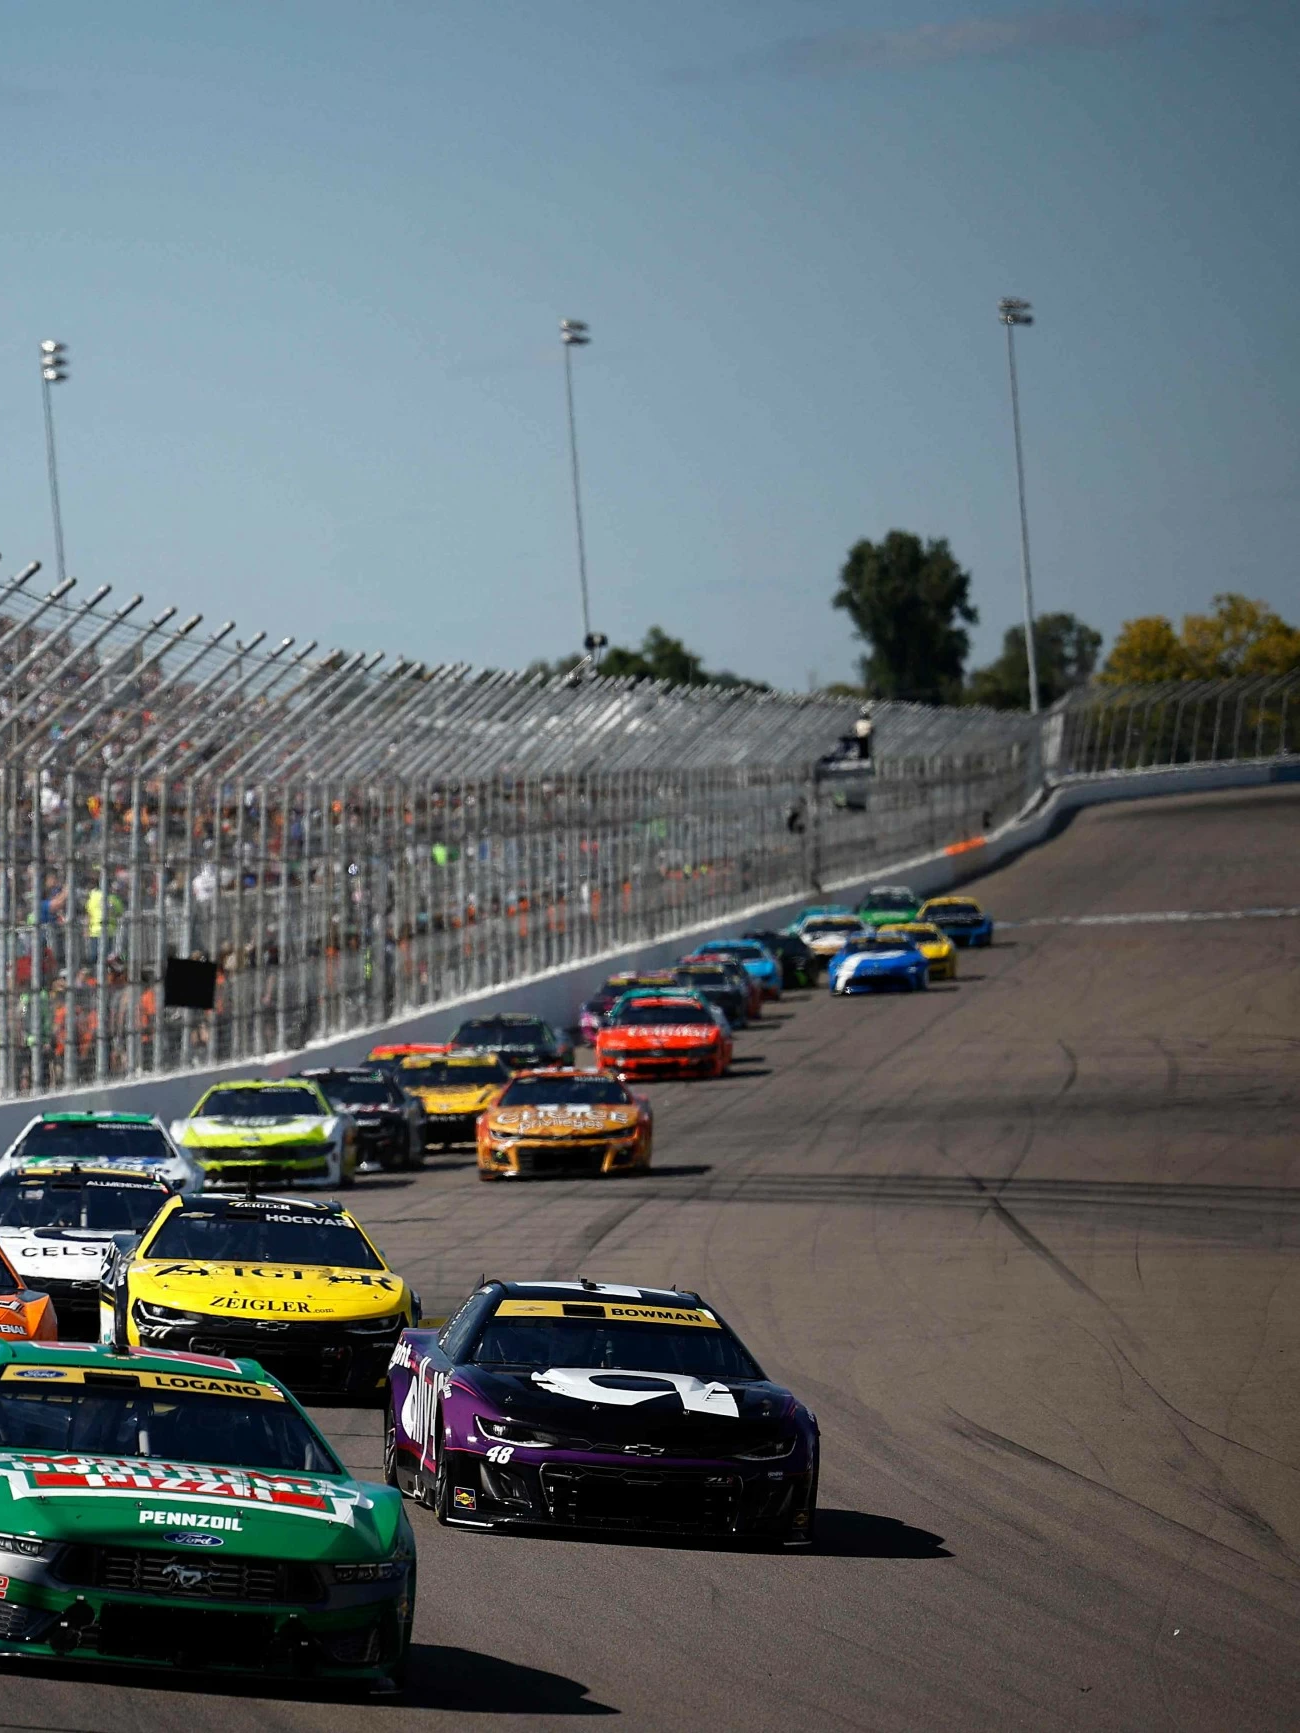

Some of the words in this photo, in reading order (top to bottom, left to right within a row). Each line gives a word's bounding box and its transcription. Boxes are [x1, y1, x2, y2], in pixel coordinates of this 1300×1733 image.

[232, 1201, 291, 1211] ZEIGLER
[21, 1246, 109, 1257] CELSI
[611, 1308, 702, 1322] BOWMAN
[150, 1325, 173, 1339] 77
[155, 1376, 262, 1397] LOGANO
[485, 1445, 515, 1465] 48
[139, 1510, 243, 1532] PENNZOIL
